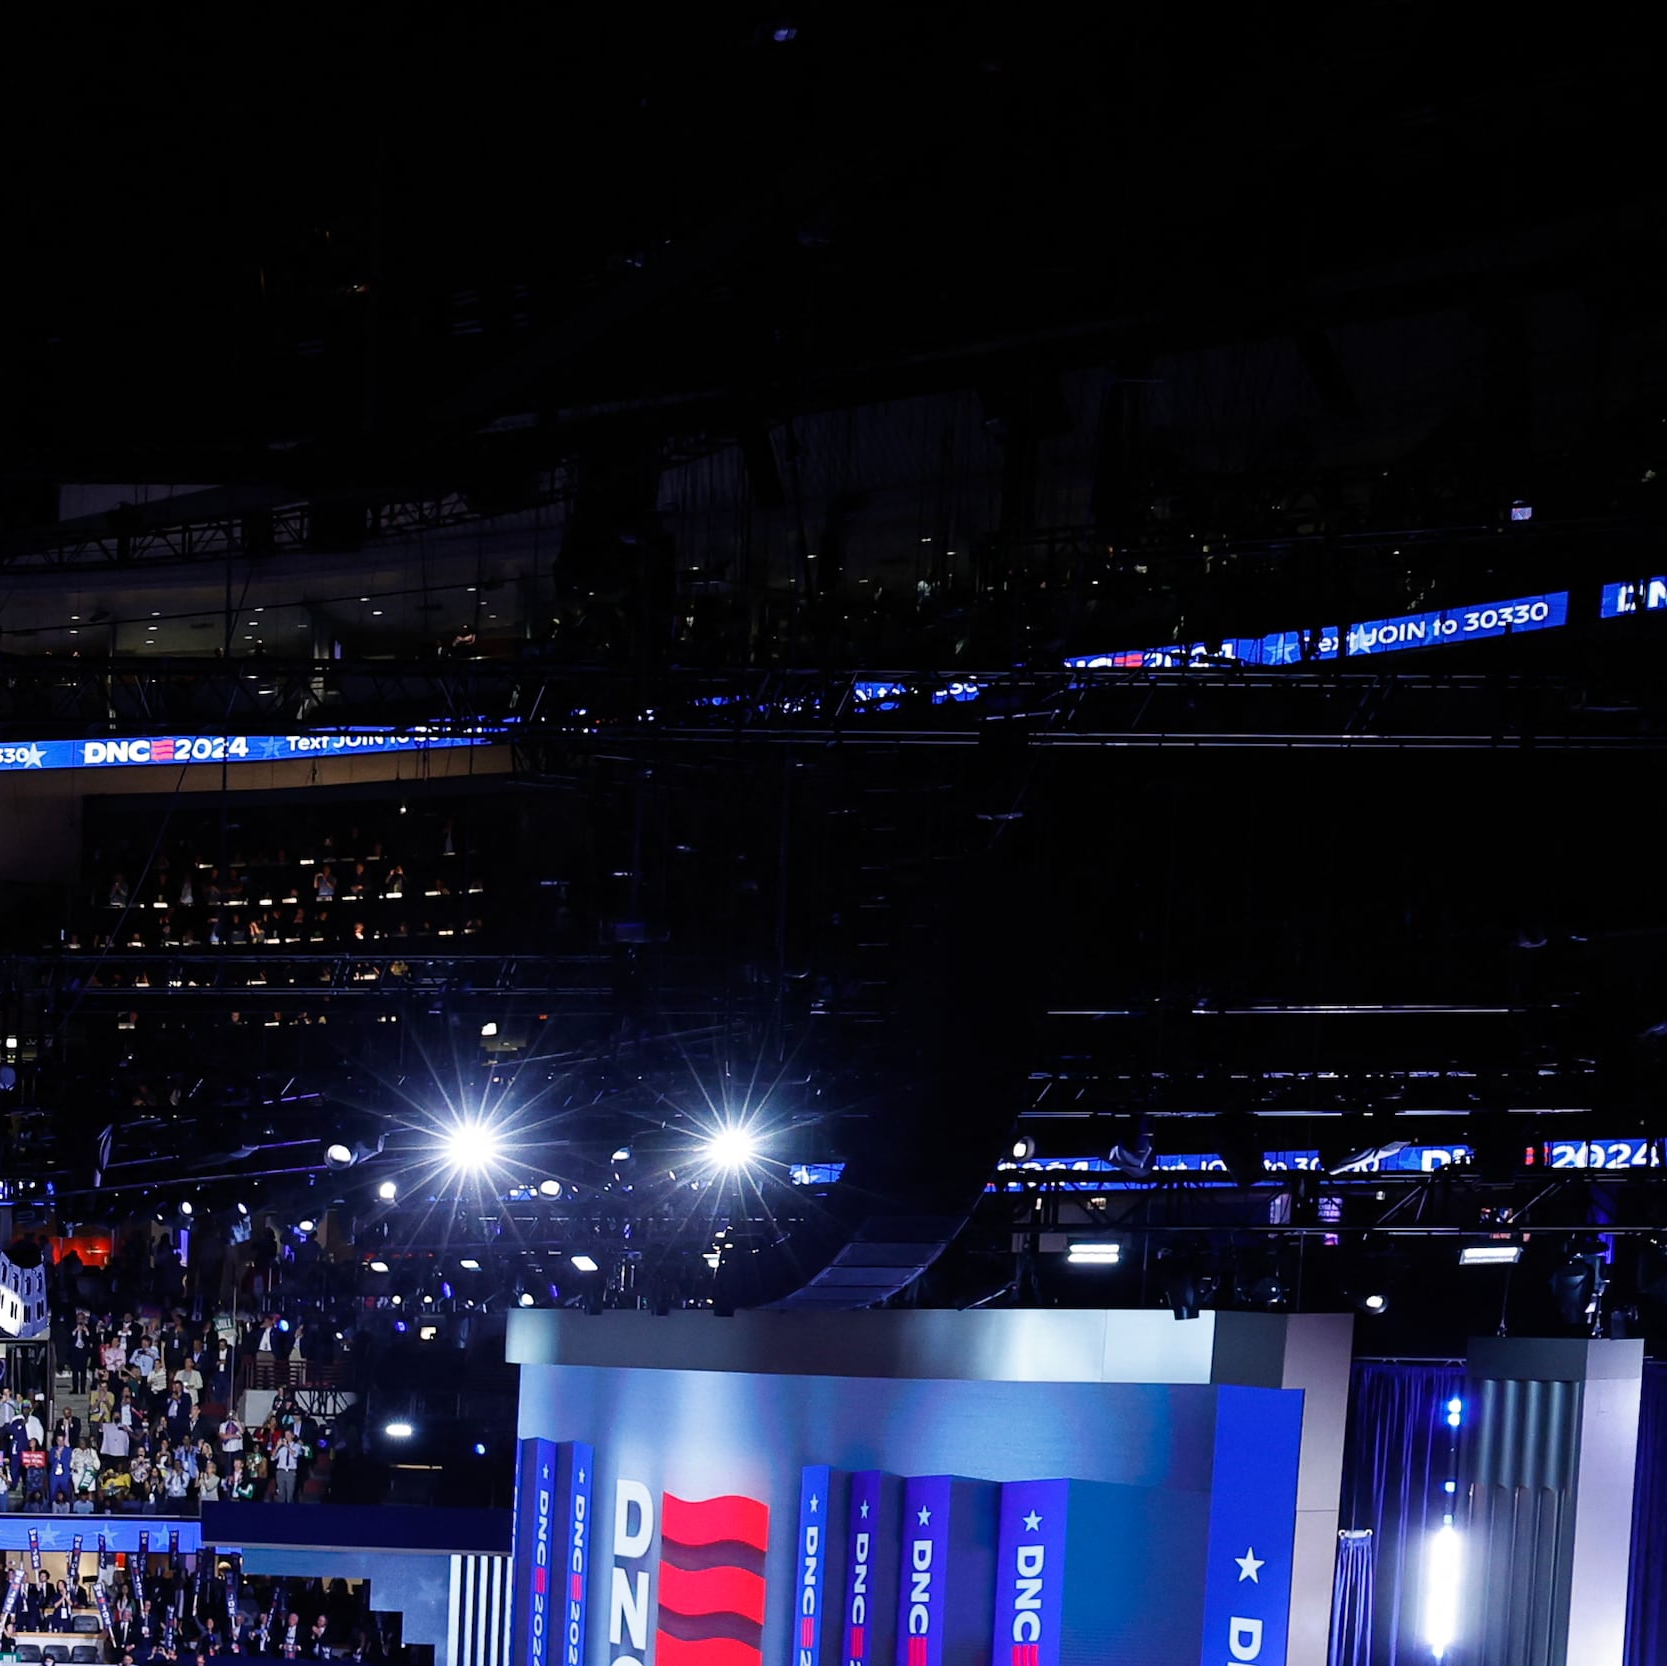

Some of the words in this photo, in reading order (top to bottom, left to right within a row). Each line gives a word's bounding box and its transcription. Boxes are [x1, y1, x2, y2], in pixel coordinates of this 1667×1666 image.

[1365, 619, 1426, 651] JOIN
[1433, 616, 1456, 637] to
[1466, 603, 1549, 633] 30330
[85, 741, 151, 763] DNC
[174, 738, 249, 760] 2024
[287, 736, 328, 751] Text
[1552, 1142, 1654, 1169] 2024
[531, 1490, 551, 1566] DNC
[568, 1493, 588, 1575] DNC
[798, 1525, 821, 1616] DNC
[851, 1531, 871, 1626] DNC
[908, 1538, 933, 1635] DNC
[1011, 1543, 1045, 1644] DNC
